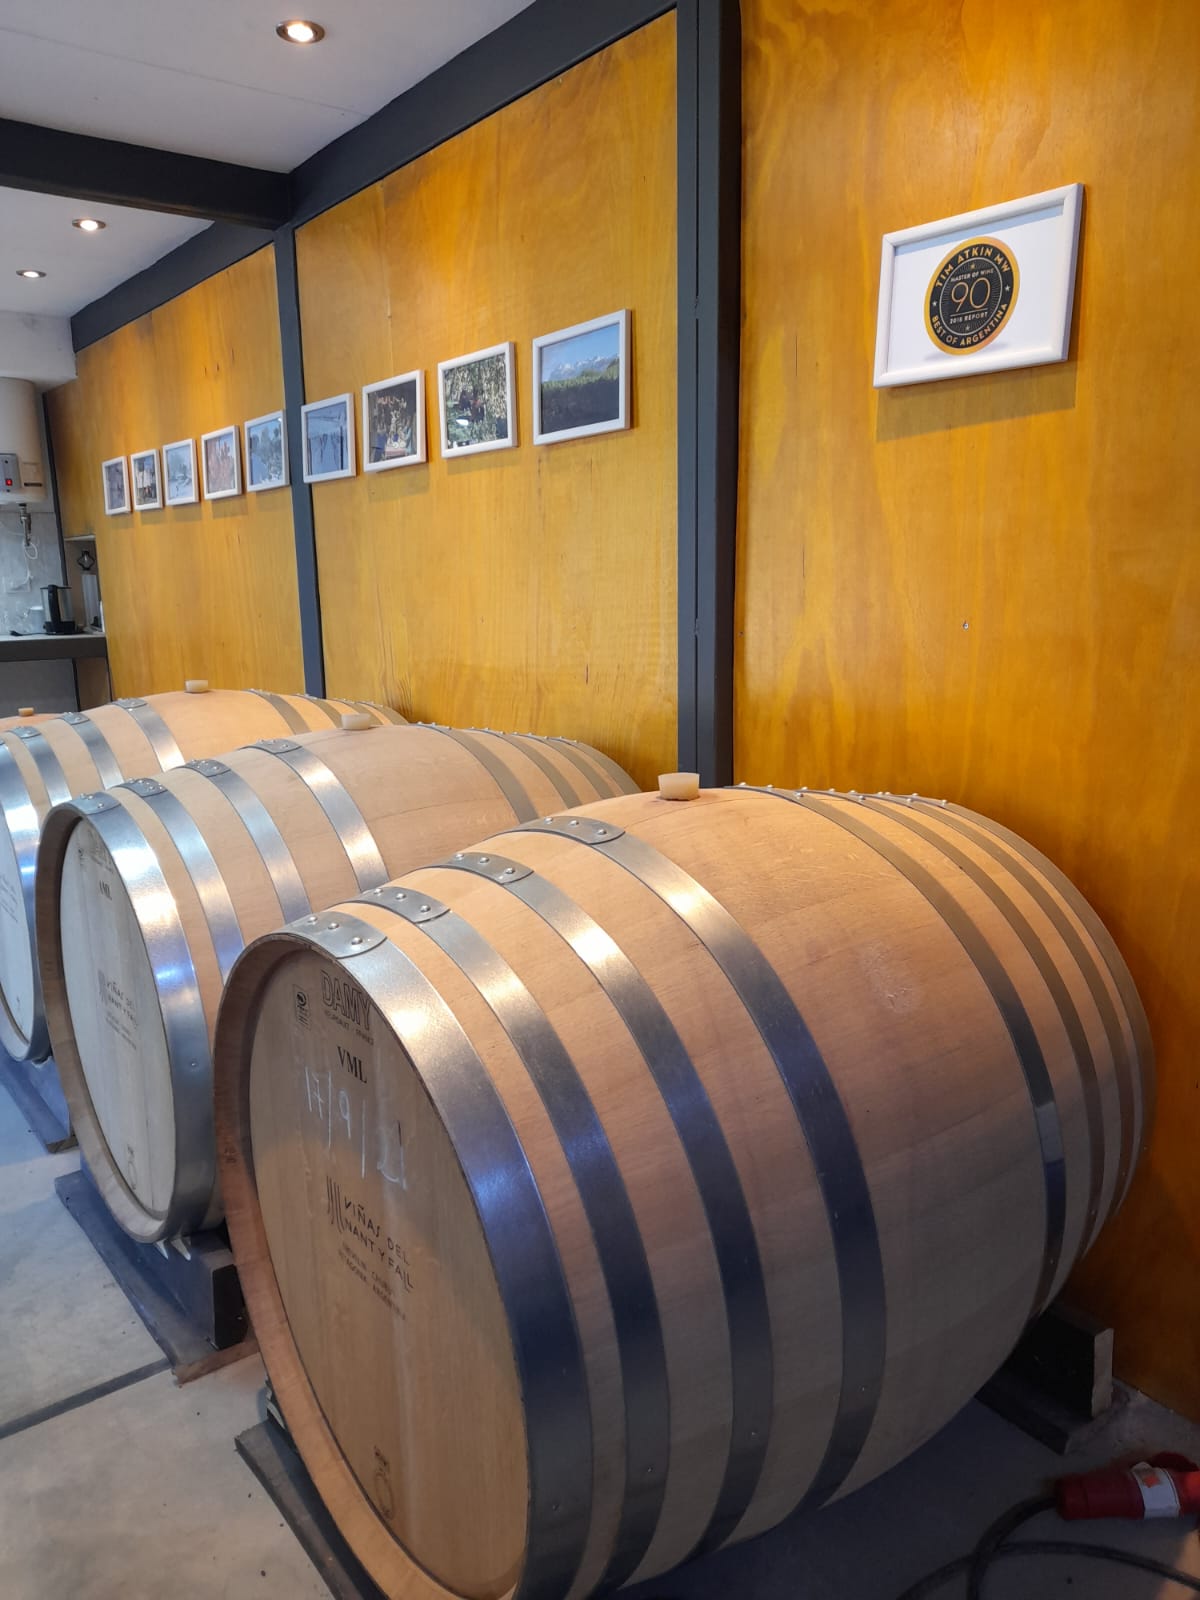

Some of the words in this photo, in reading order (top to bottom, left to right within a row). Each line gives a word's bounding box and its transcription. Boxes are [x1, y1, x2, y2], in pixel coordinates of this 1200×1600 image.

[936, 264, 954, 287] TIM
[957, 247, 993, 264] ATKIN
[994, 254, 1010, 273] MW
[951, 277, 991, 312] 90
[932, 315, 946, 336] BEST
[946, 335, 958, 345] OF
[959, 303, 1008, 346] ARGENTINA
[964, 311, 988, 321] REPORT
[320, 969, 373, 1031] DAMY
[337, 1046, 368, 1083] VML
[344, 1196, 380, 1238] VIÑAS
[387, 1237, 410, 1266] DEL
[344, 1217, 375, 1252] NANT
